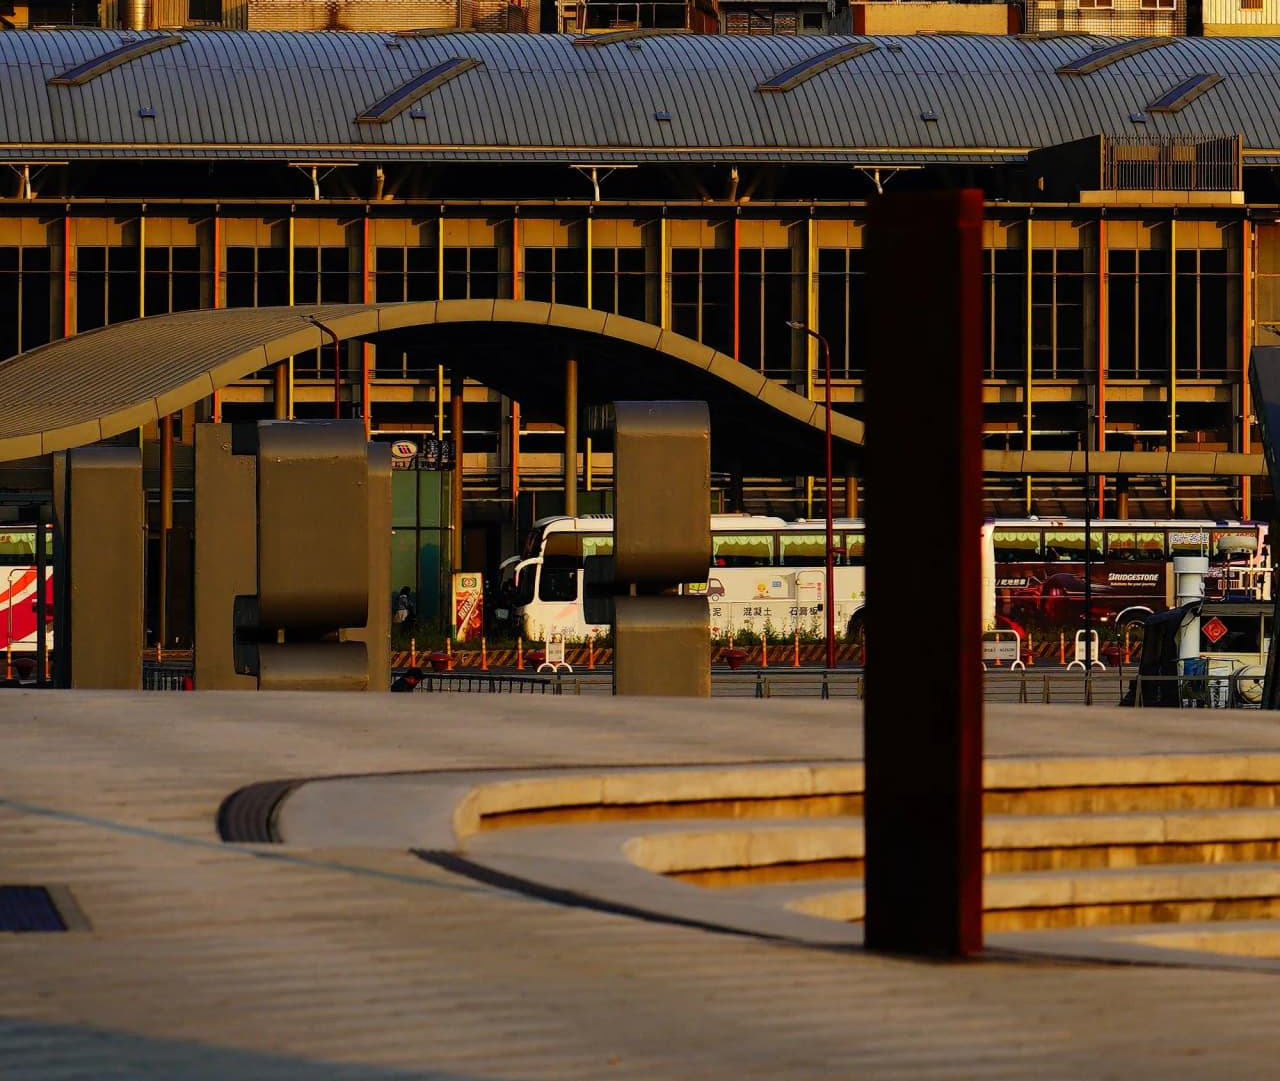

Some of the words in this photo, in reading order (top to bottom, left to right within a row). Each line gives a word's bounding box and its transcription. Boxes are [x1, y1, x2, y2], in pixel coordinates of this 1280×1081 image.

[1107, 573, 1160, 581] BRIDGESTONE
[743, 607, 773, 617] 混凝土
